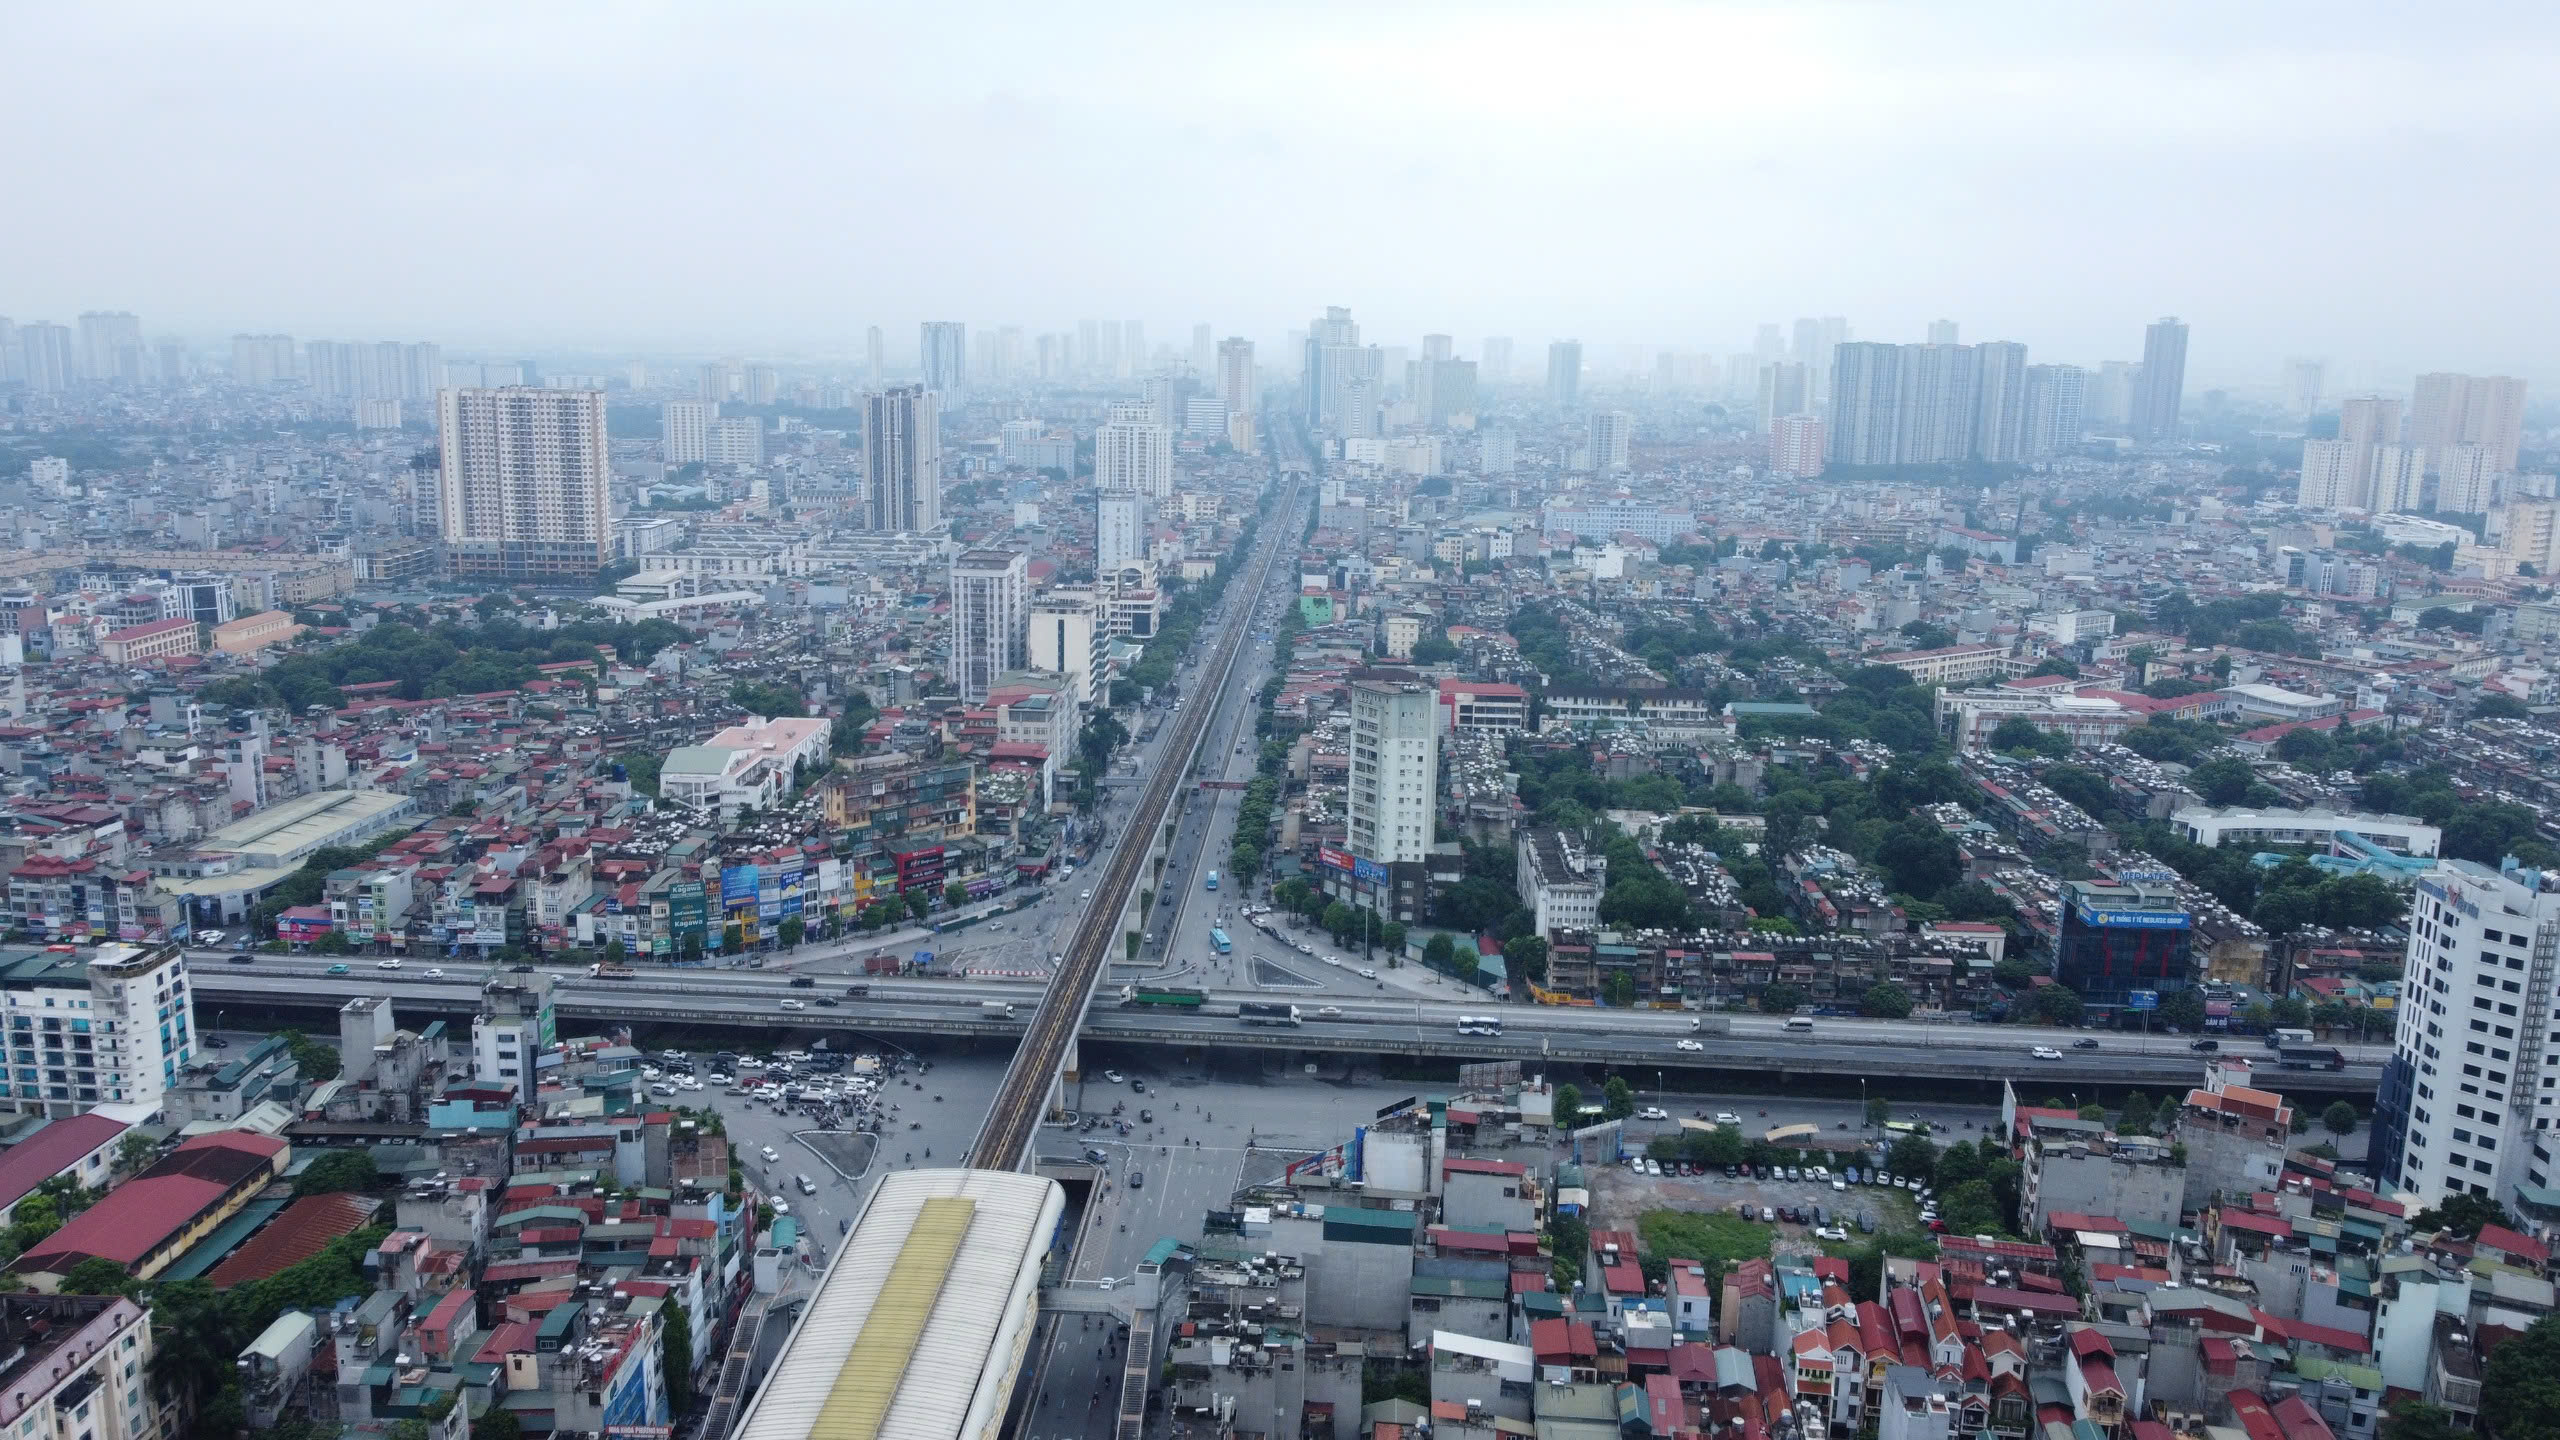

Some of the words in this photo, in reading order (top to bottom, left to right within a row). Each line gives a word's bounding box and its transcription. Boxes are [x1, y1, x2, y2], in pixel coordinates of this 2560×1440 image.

[2120, 871, 2172, 880] MEDLATEC
[674, 919, 703, 928] Kagawa
[608, 1426, 620, 1434] NHA
[620, 1426, 634, 1434] KHOA
[656, 1426, 669, 1434] NAM
